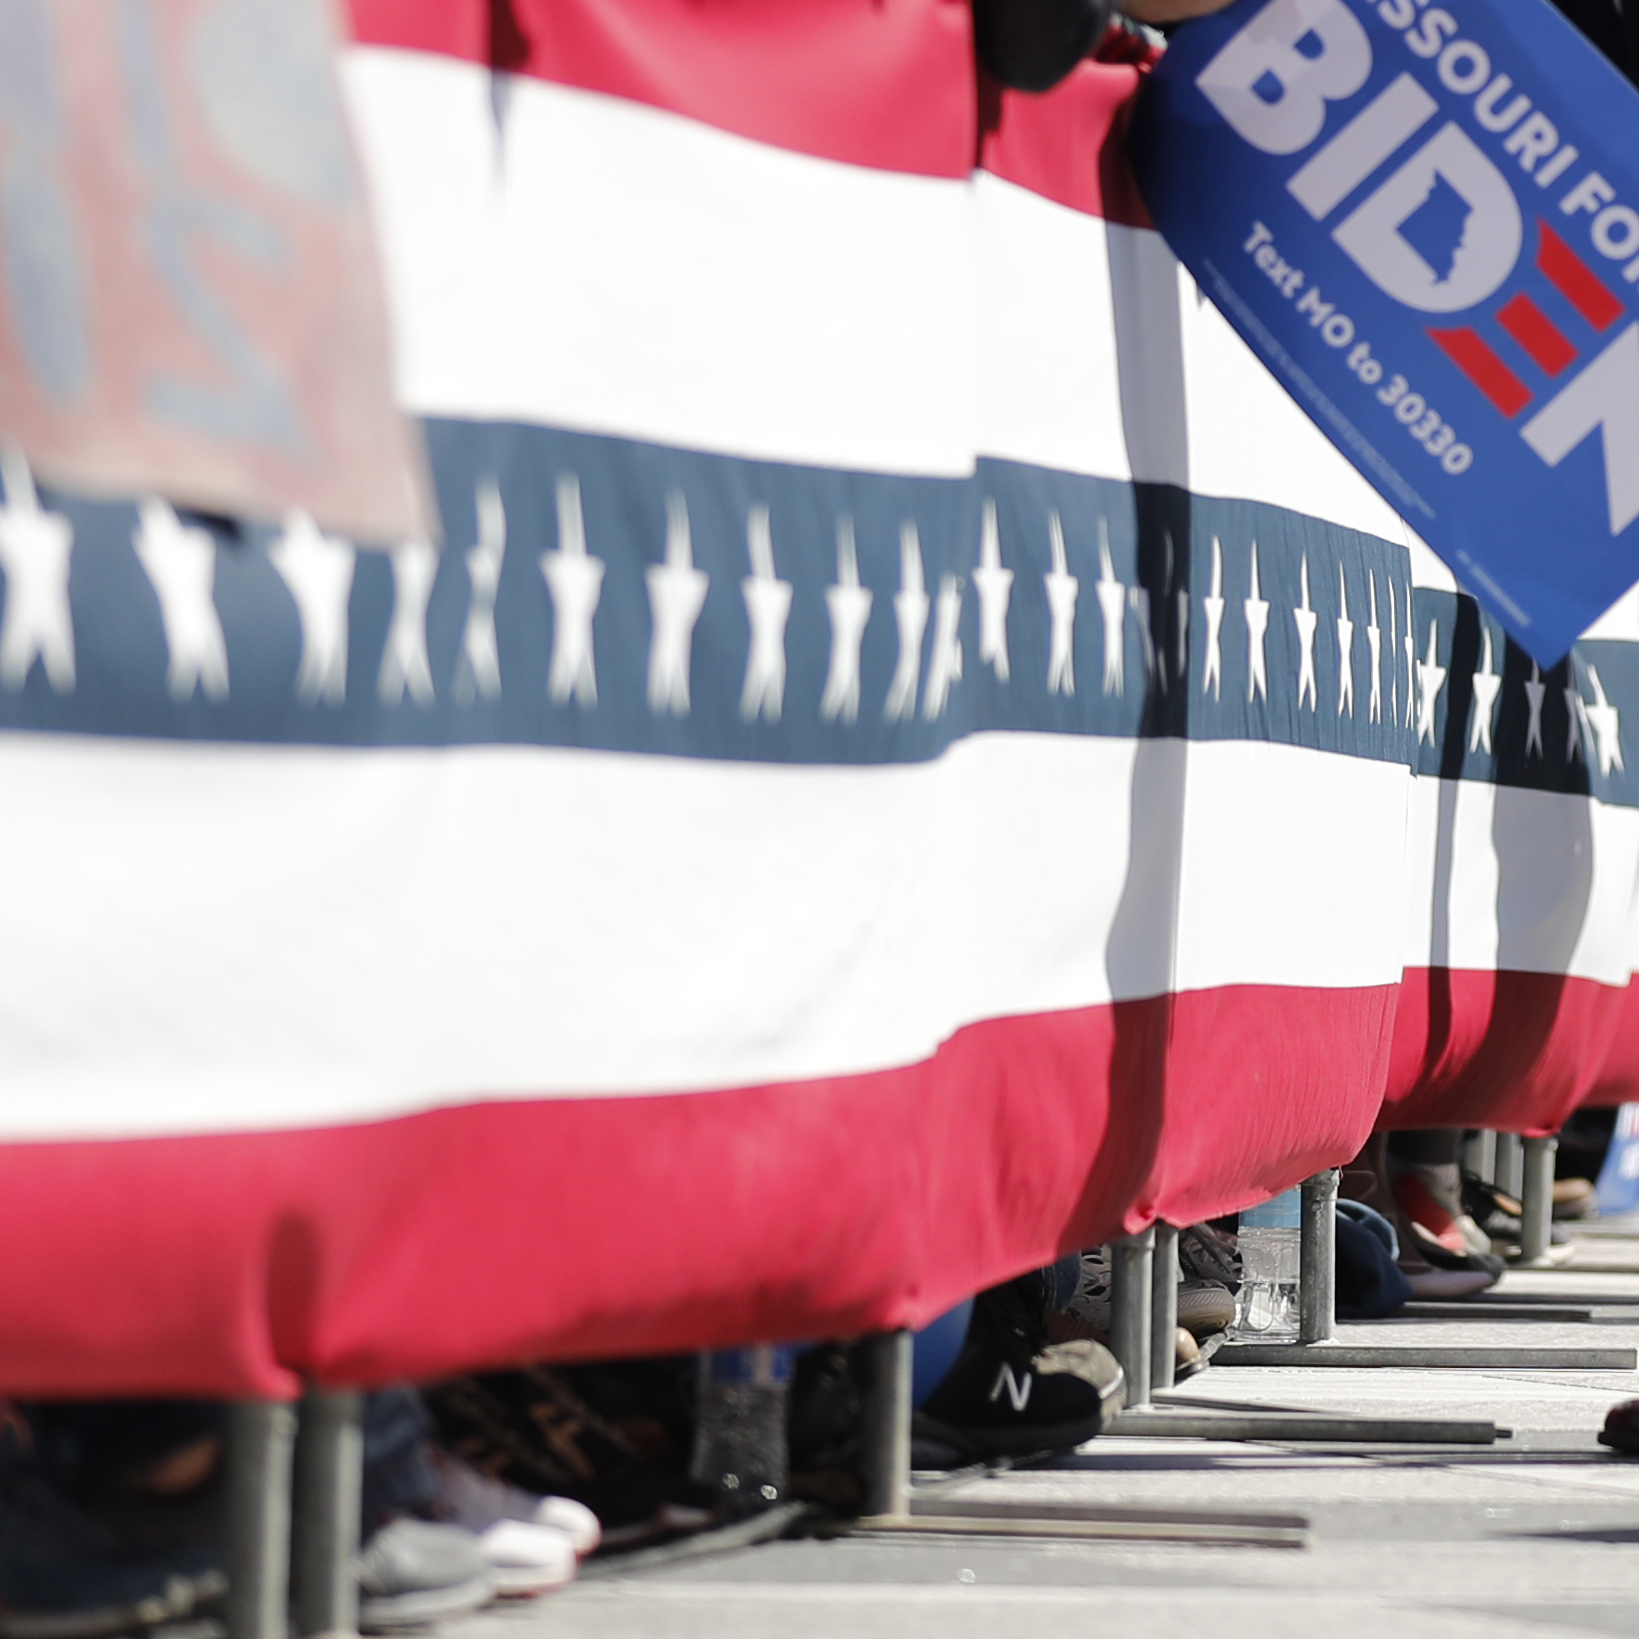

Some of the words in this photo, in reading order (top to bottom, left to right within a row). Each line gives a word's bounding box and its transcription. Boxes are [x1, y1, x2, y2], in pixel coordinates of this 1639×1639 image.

[1243, 221, 1305, 299] Text
[1296, 285, 1355, 348] MO
[1347, 341, 1383, 385] to
[1376, 374, 1474, 475] 30330
